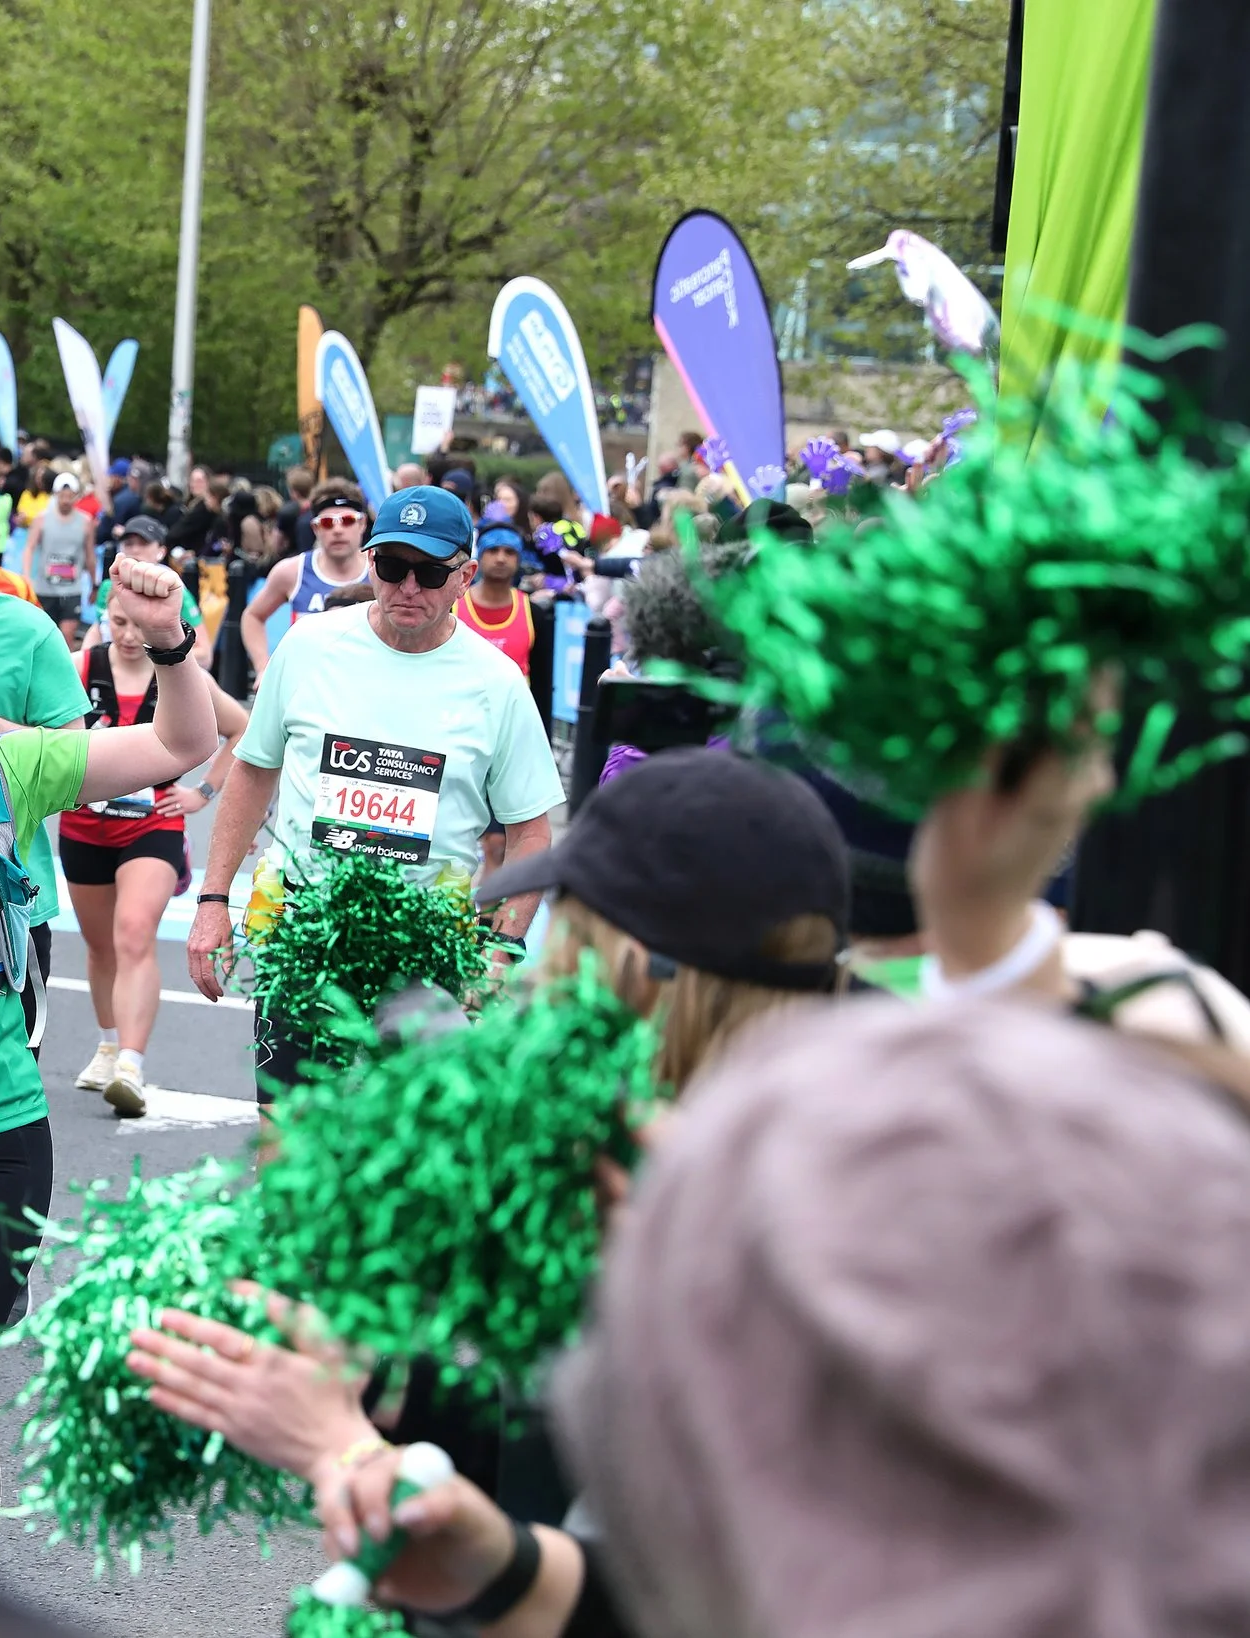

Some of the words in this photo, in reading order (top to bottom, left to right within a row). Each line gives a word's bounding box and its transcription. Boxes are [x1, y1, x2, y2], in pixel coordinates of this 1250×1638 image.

[329, 740, 372, 773] tcs
[378, 748, 404, 759] TATA
[374, 766, 413, 781] SERVICES
[375, 757, 437, 776] CONSULTANCY
[336, 787, 416, 827] 19644
[355, 844, 376, 854] new
[377, 845, 419, 862] balance
